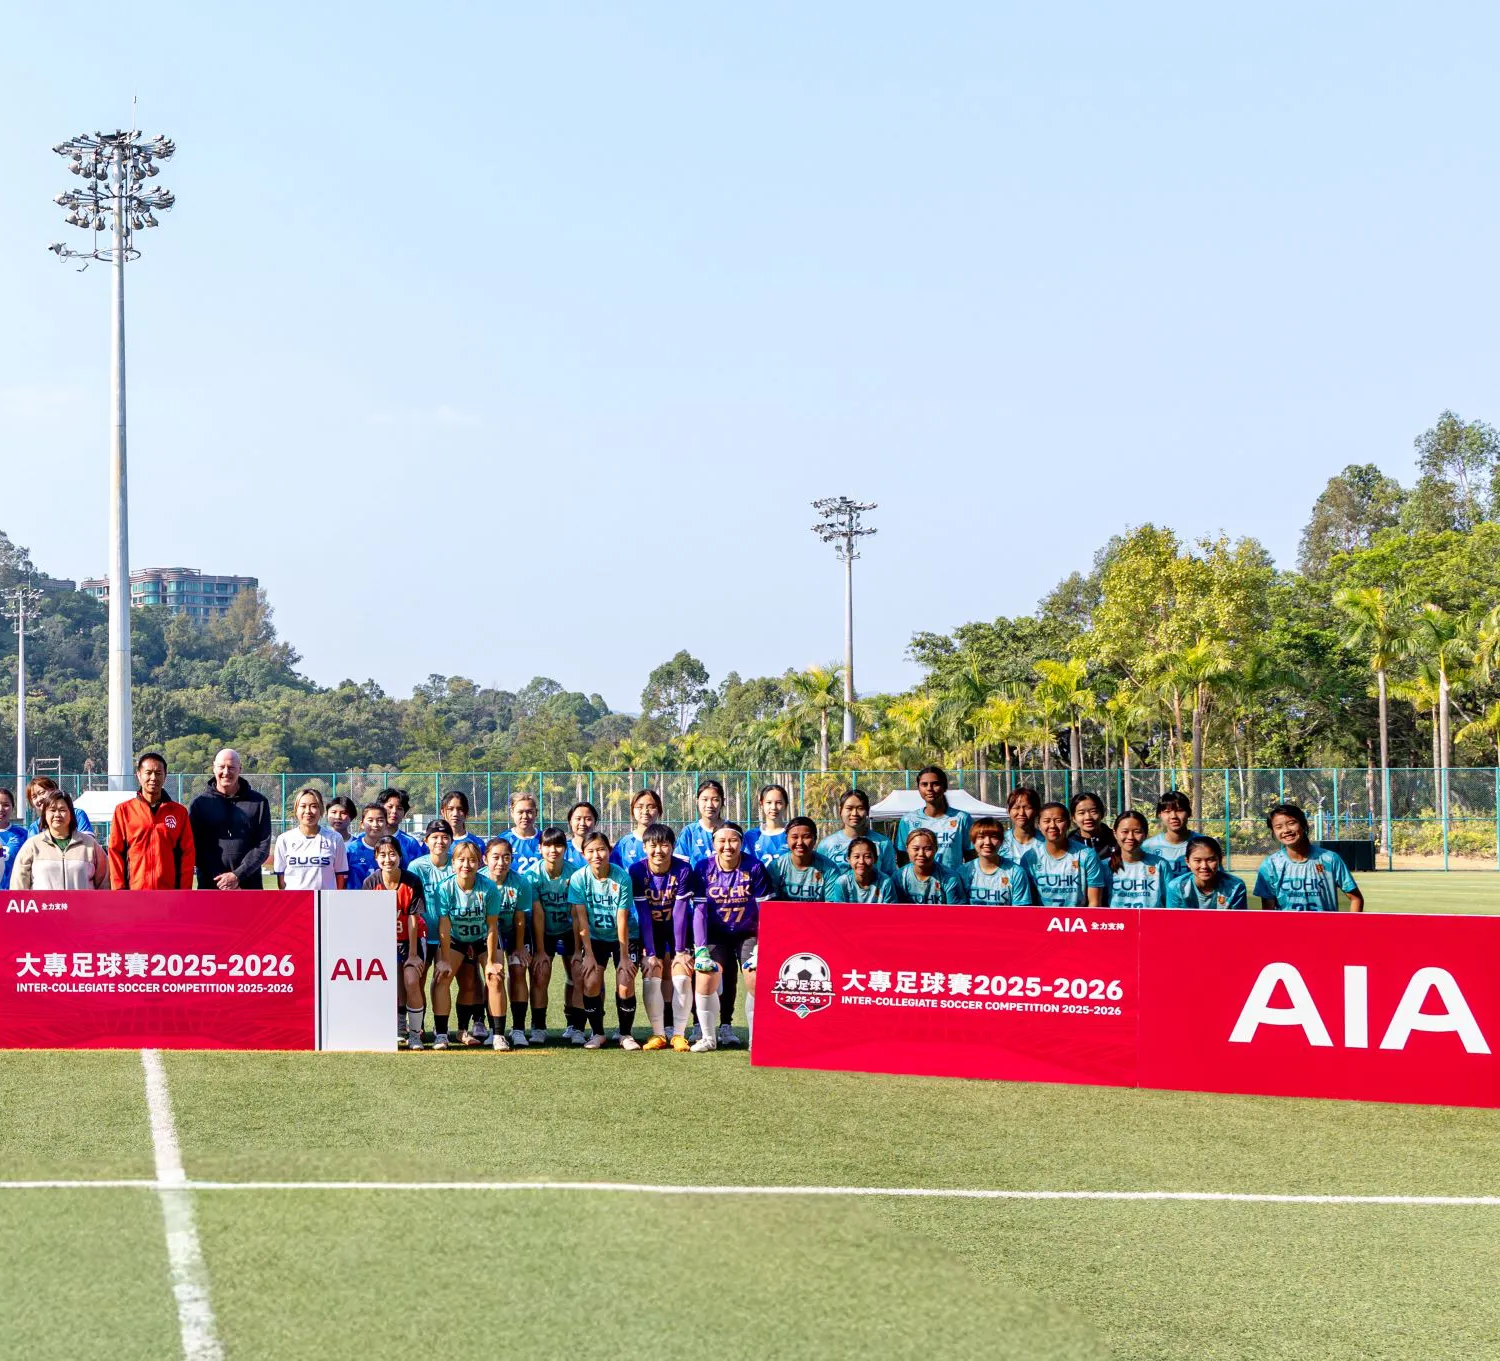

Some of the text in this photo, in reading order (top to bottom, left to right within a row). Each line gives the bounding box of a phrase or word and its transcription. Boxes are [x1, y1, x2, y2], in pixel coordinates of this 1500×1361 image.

[288, 856, 331, 866] BUGS
[1036, 875, 1081, 887] CUHK
[1112, 879, 1156, 891] CUHK
[1280, 879, 1324, 891] CUHK
[709, 885, 752, 897] CUHK
[6, 899, 68, 913] AIA 全力支持
[652, 908, 672, 921] 27
[719, 906, 746, 922] 77
[594, 913, 615, 929] 29
[1047, 917, 1124, 933] AIA 全力支持
[458, 924, 481, 936] 30
[16, 953, 295, 978] 大專足球賽2025-2026
[330, 958, 388, 981] AIA
[17, 983, 294, 993] INTER-COLLEGIATE SOCCER COMPETITION 2025-2026
[842, 969, 1124, 1001] 大專足球賽2025-2026
[785, 995, 821, 1004] 2025-26
[841, 995, 1122, 1016] INTER-COLLEGIATE SOCCER COMPETITION 2025-2026
[1228, 962, 1492, 1054] AIA
